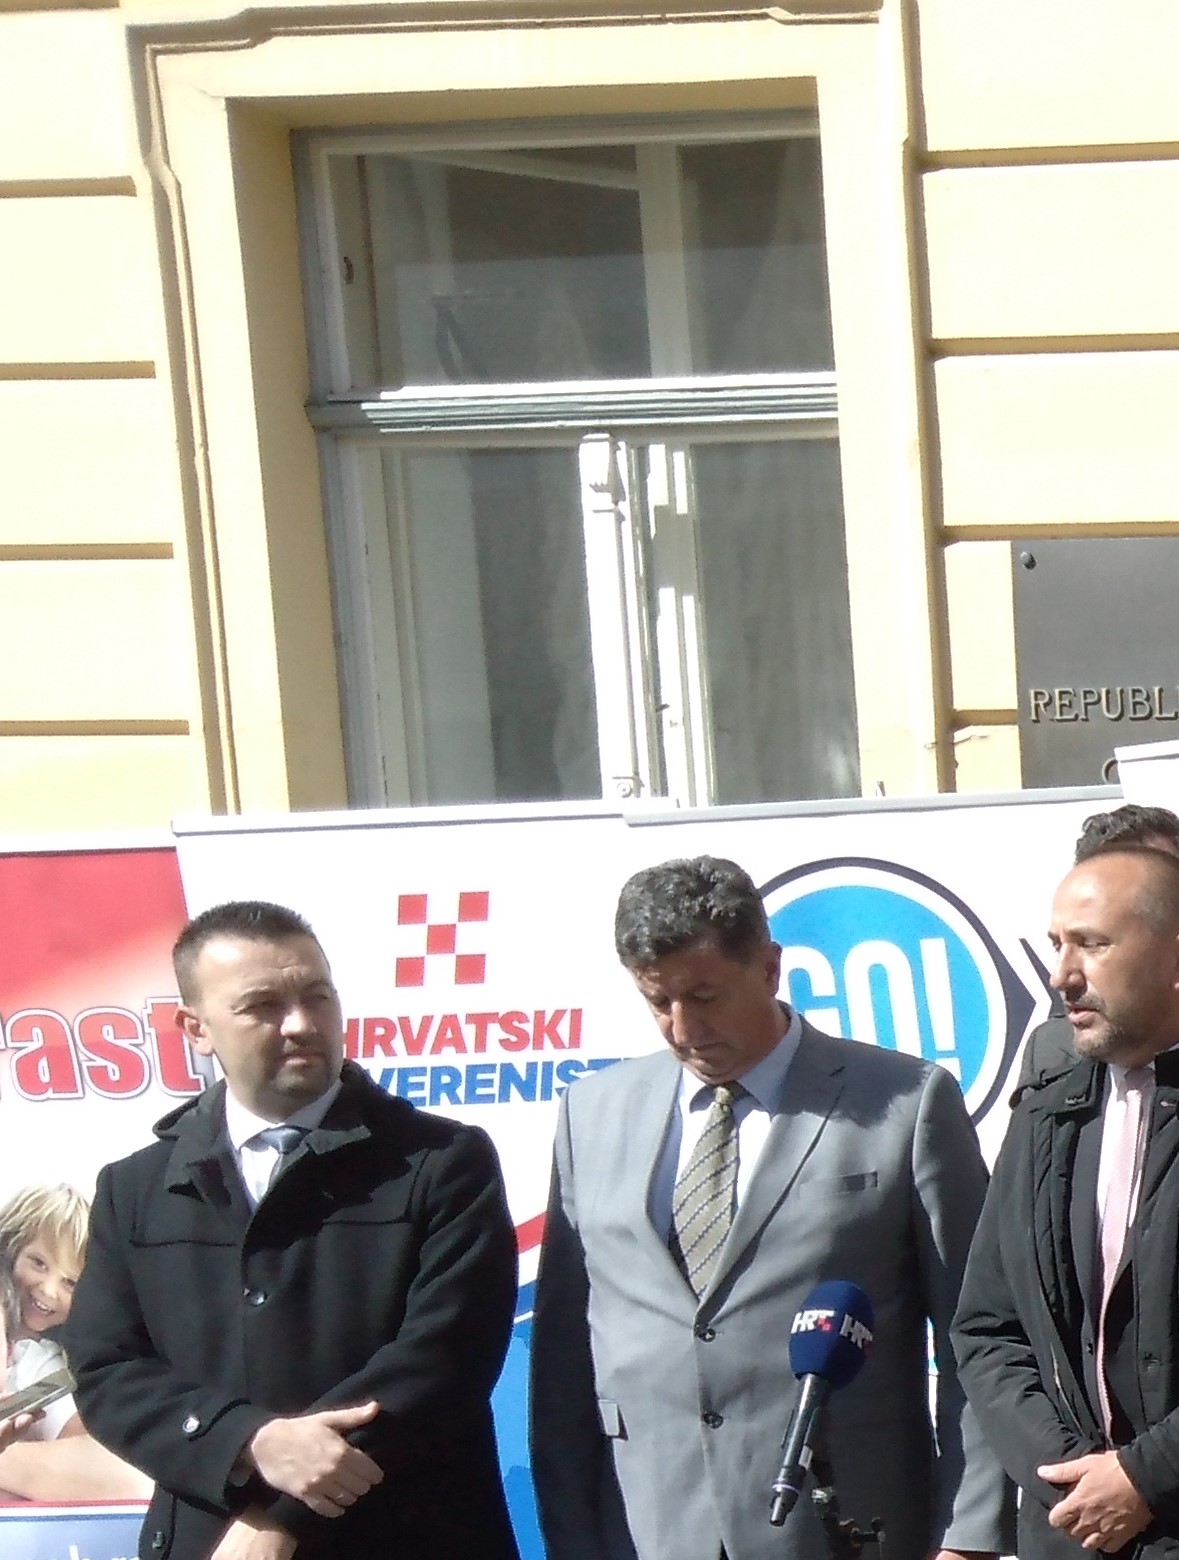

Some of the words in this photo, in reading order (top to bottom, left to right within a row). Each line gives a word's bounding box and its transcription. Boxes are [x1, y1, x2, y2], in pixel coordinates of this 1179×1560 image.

[0, 996, 206, 1103] ast
[365, 1057, 632, 1108] ERENIS
[791, 1309, 835, 1334] HRT
